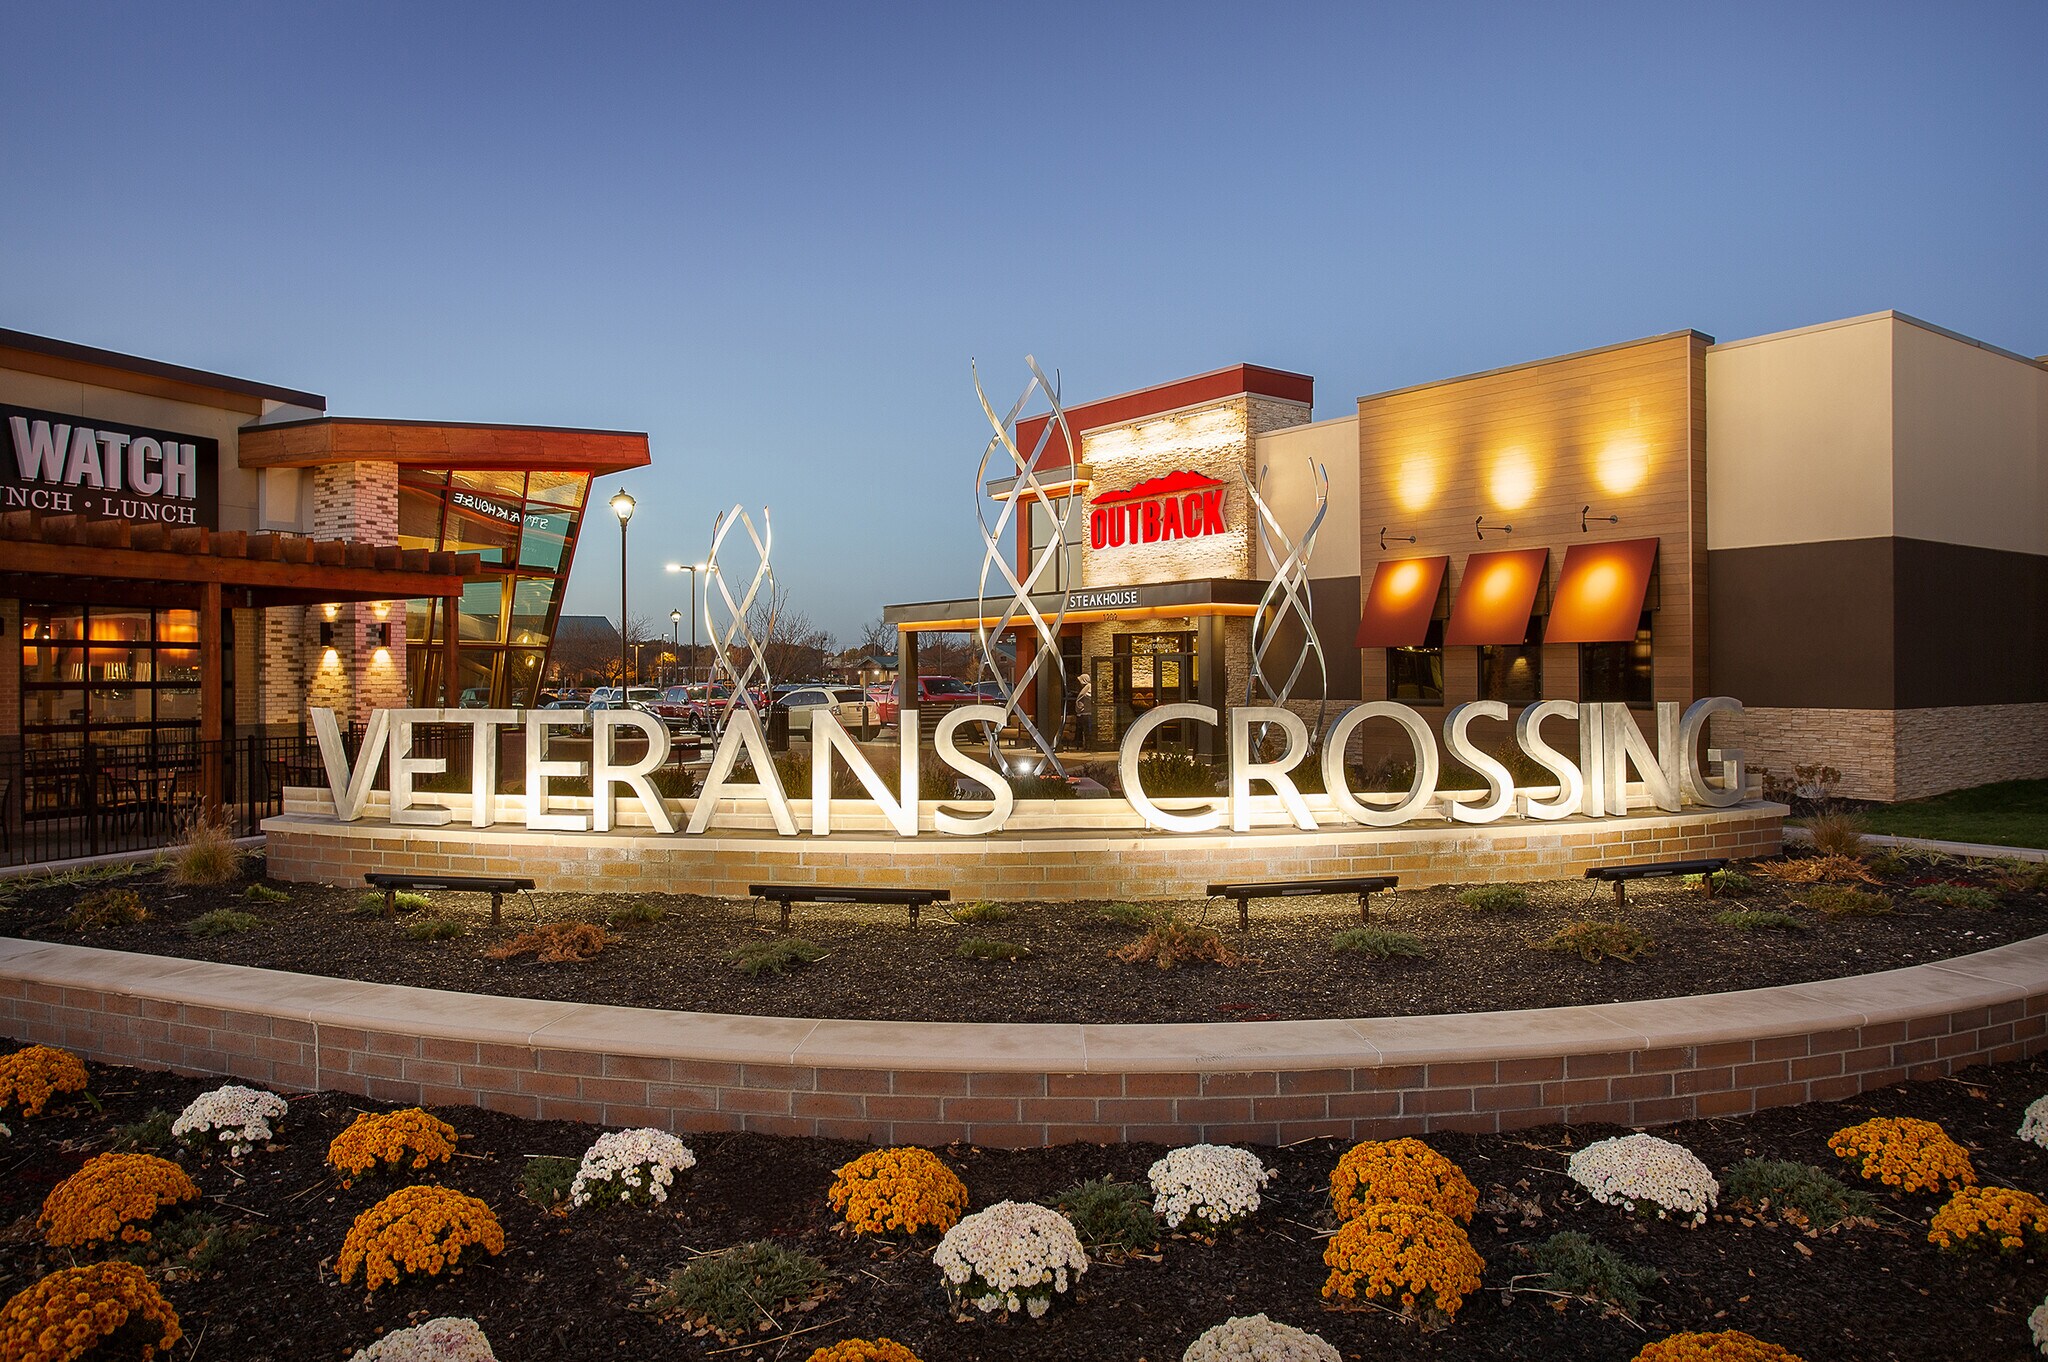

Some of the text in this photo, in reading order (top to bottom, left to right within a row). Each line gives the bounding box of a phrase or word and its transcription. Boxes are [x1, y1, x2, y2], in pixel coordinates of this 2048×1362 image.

[9, 416, 196, 500] WATCH
[0, 486, 196, 524] NCH LUNCH
[1090, 490, 1226, 549] OUTBACK
[1069, 591, 1137, 608] STEAKHOUSE
[310, 697, 1746, 836] VETERANS CROSSING
